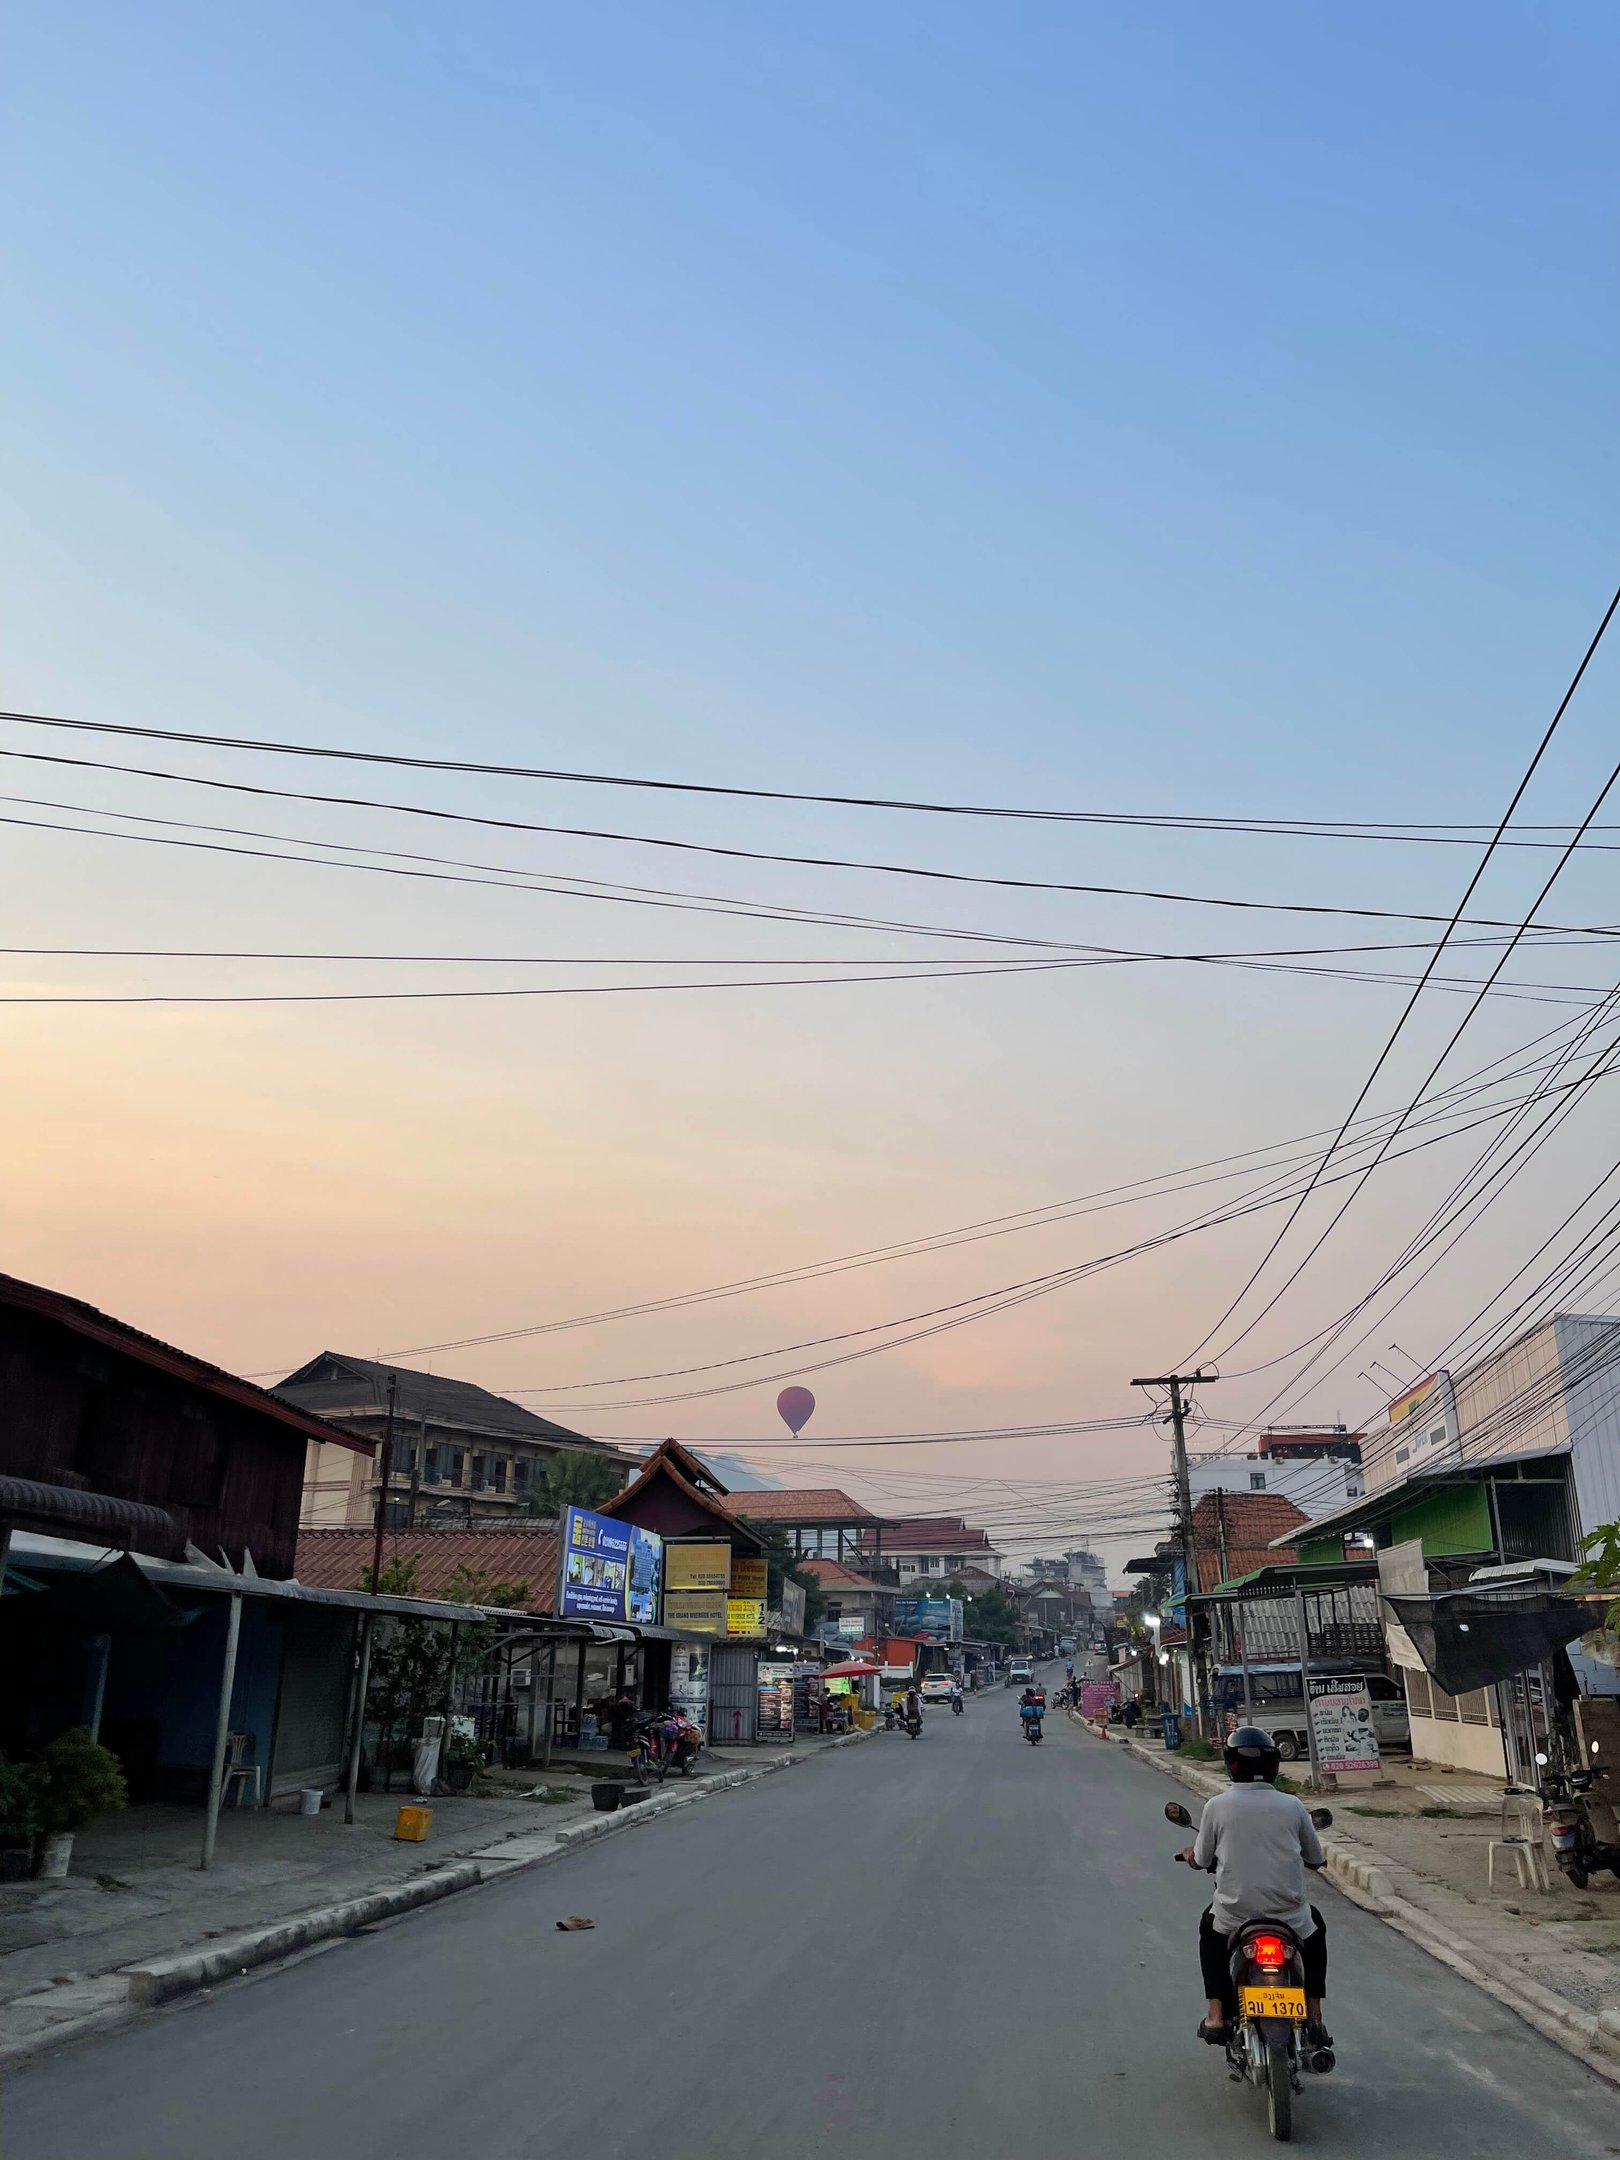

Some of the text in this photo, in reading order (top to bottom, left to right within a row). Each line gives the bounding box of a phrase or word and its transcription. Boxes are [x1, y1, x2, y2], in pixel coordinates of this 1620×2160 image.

[758, 1603, 764, 1611] 1
[1331, 1762, 1344, 1770] 020
[1272, 2002, 1304, 2015] 1370
